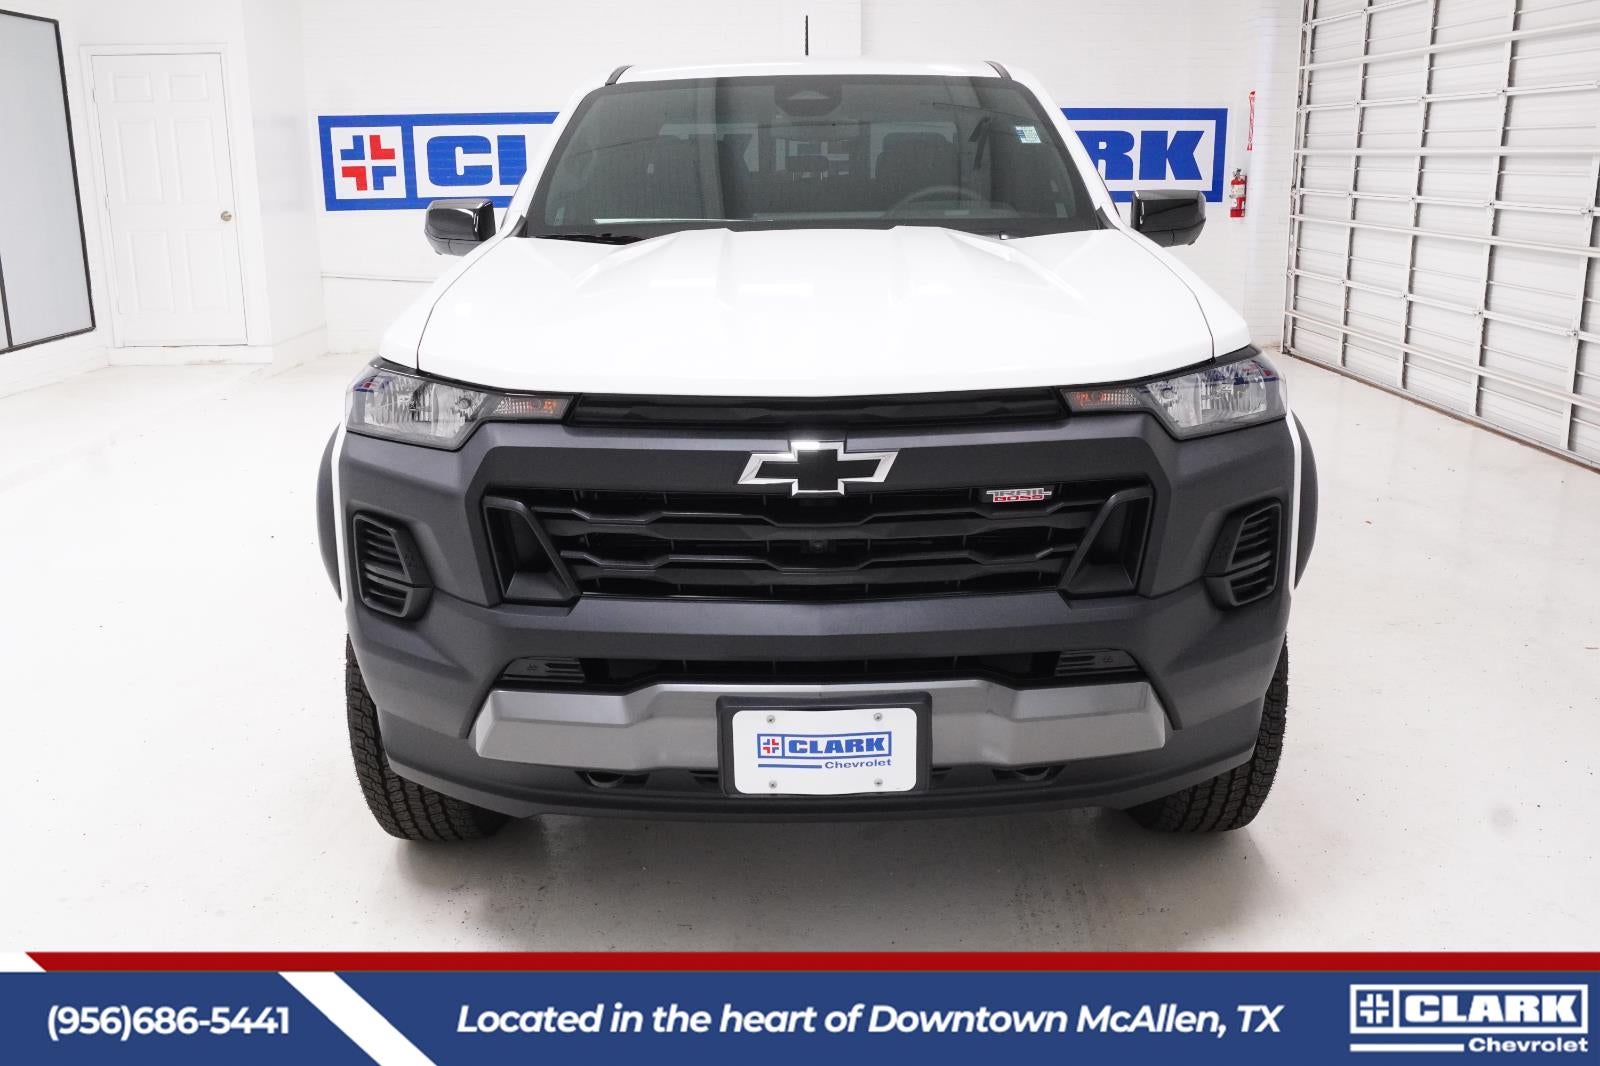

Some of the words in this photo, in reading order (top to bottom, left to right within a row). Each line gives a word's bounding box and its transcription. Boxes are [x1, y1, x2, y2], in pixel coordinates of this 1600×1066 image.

[986, 487, 1053, 497] TRAIL
[992, 494, 1044, 503] BOSS
[788, 737, 886, 754] CLARK
[824, 758, 892, 770] Chevrolet
